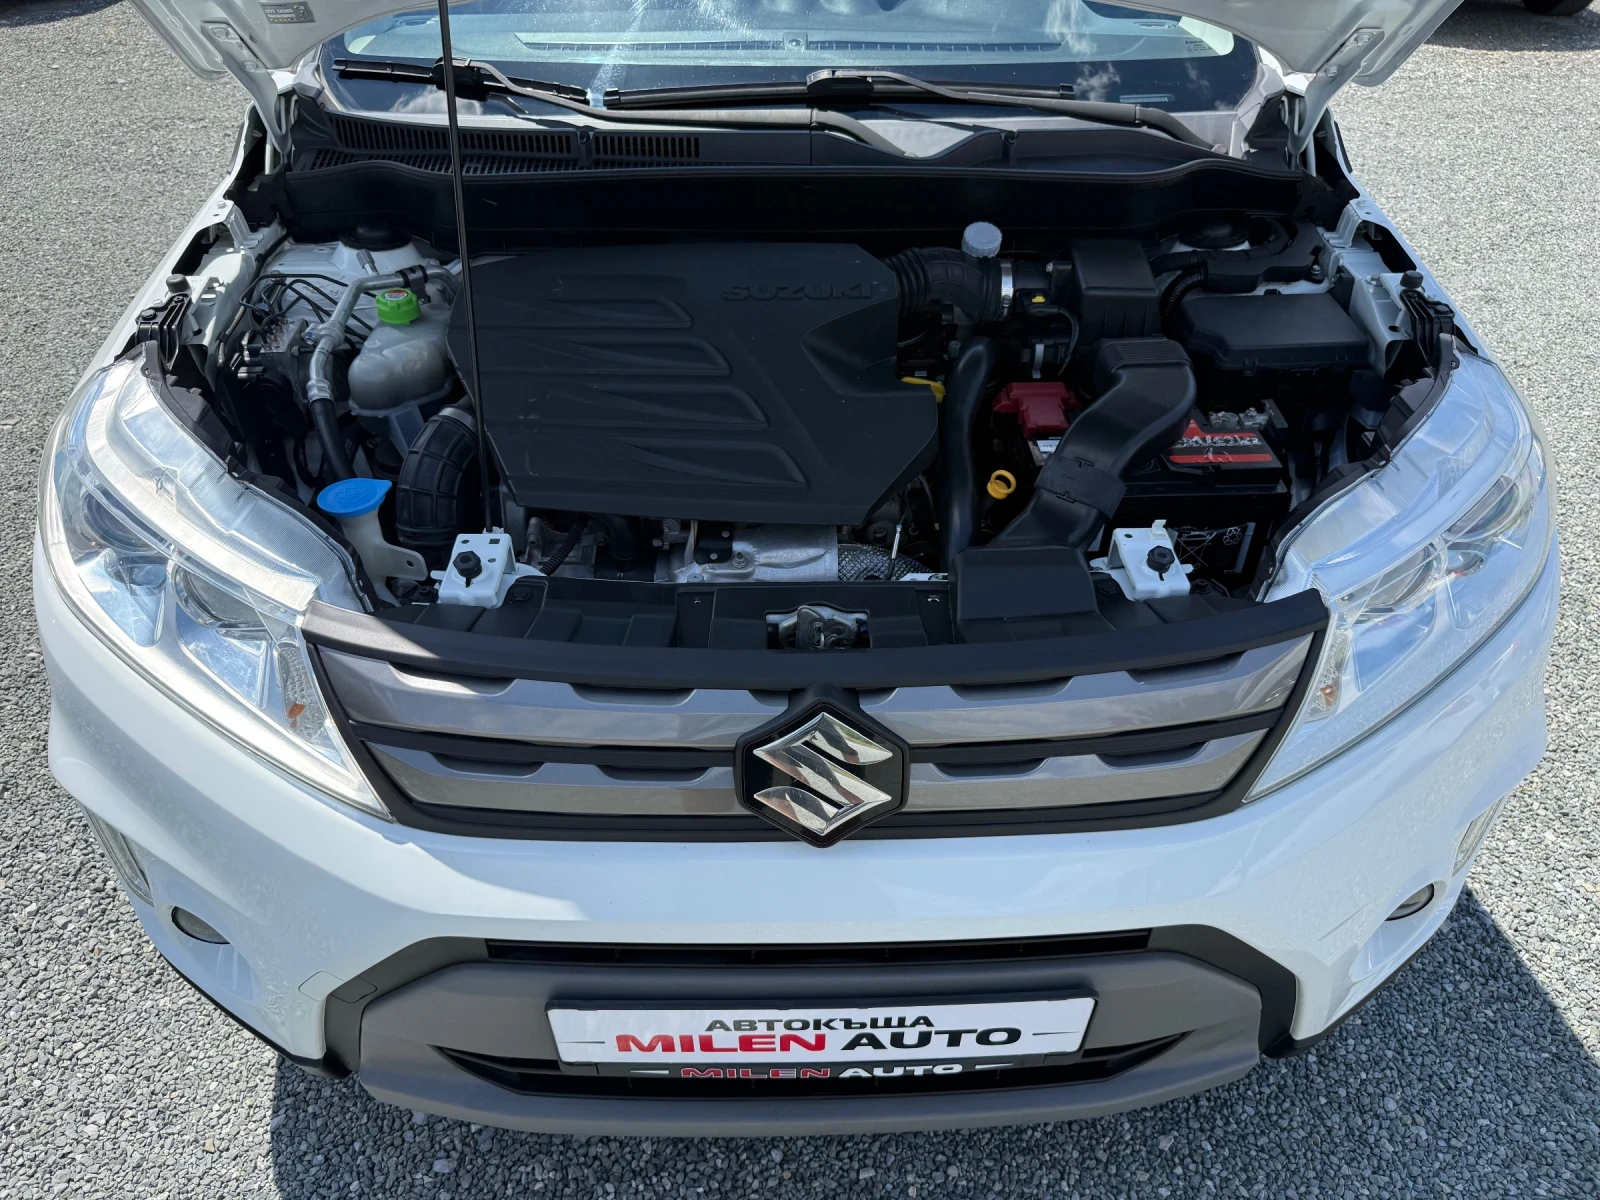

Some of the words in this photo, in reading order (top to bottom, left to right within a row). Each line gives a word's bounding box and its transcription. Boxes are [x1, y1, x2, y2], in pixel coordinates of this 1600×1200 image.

[720, 282, 872, 302] SUZUKI
[615, 1033, 826, 1052] MILEN
[840, 1027, 1022, 1050] AUTO
[681, 1067, 830, 1079] MILEN
[838, 1064, 963, 1078] AUTO
